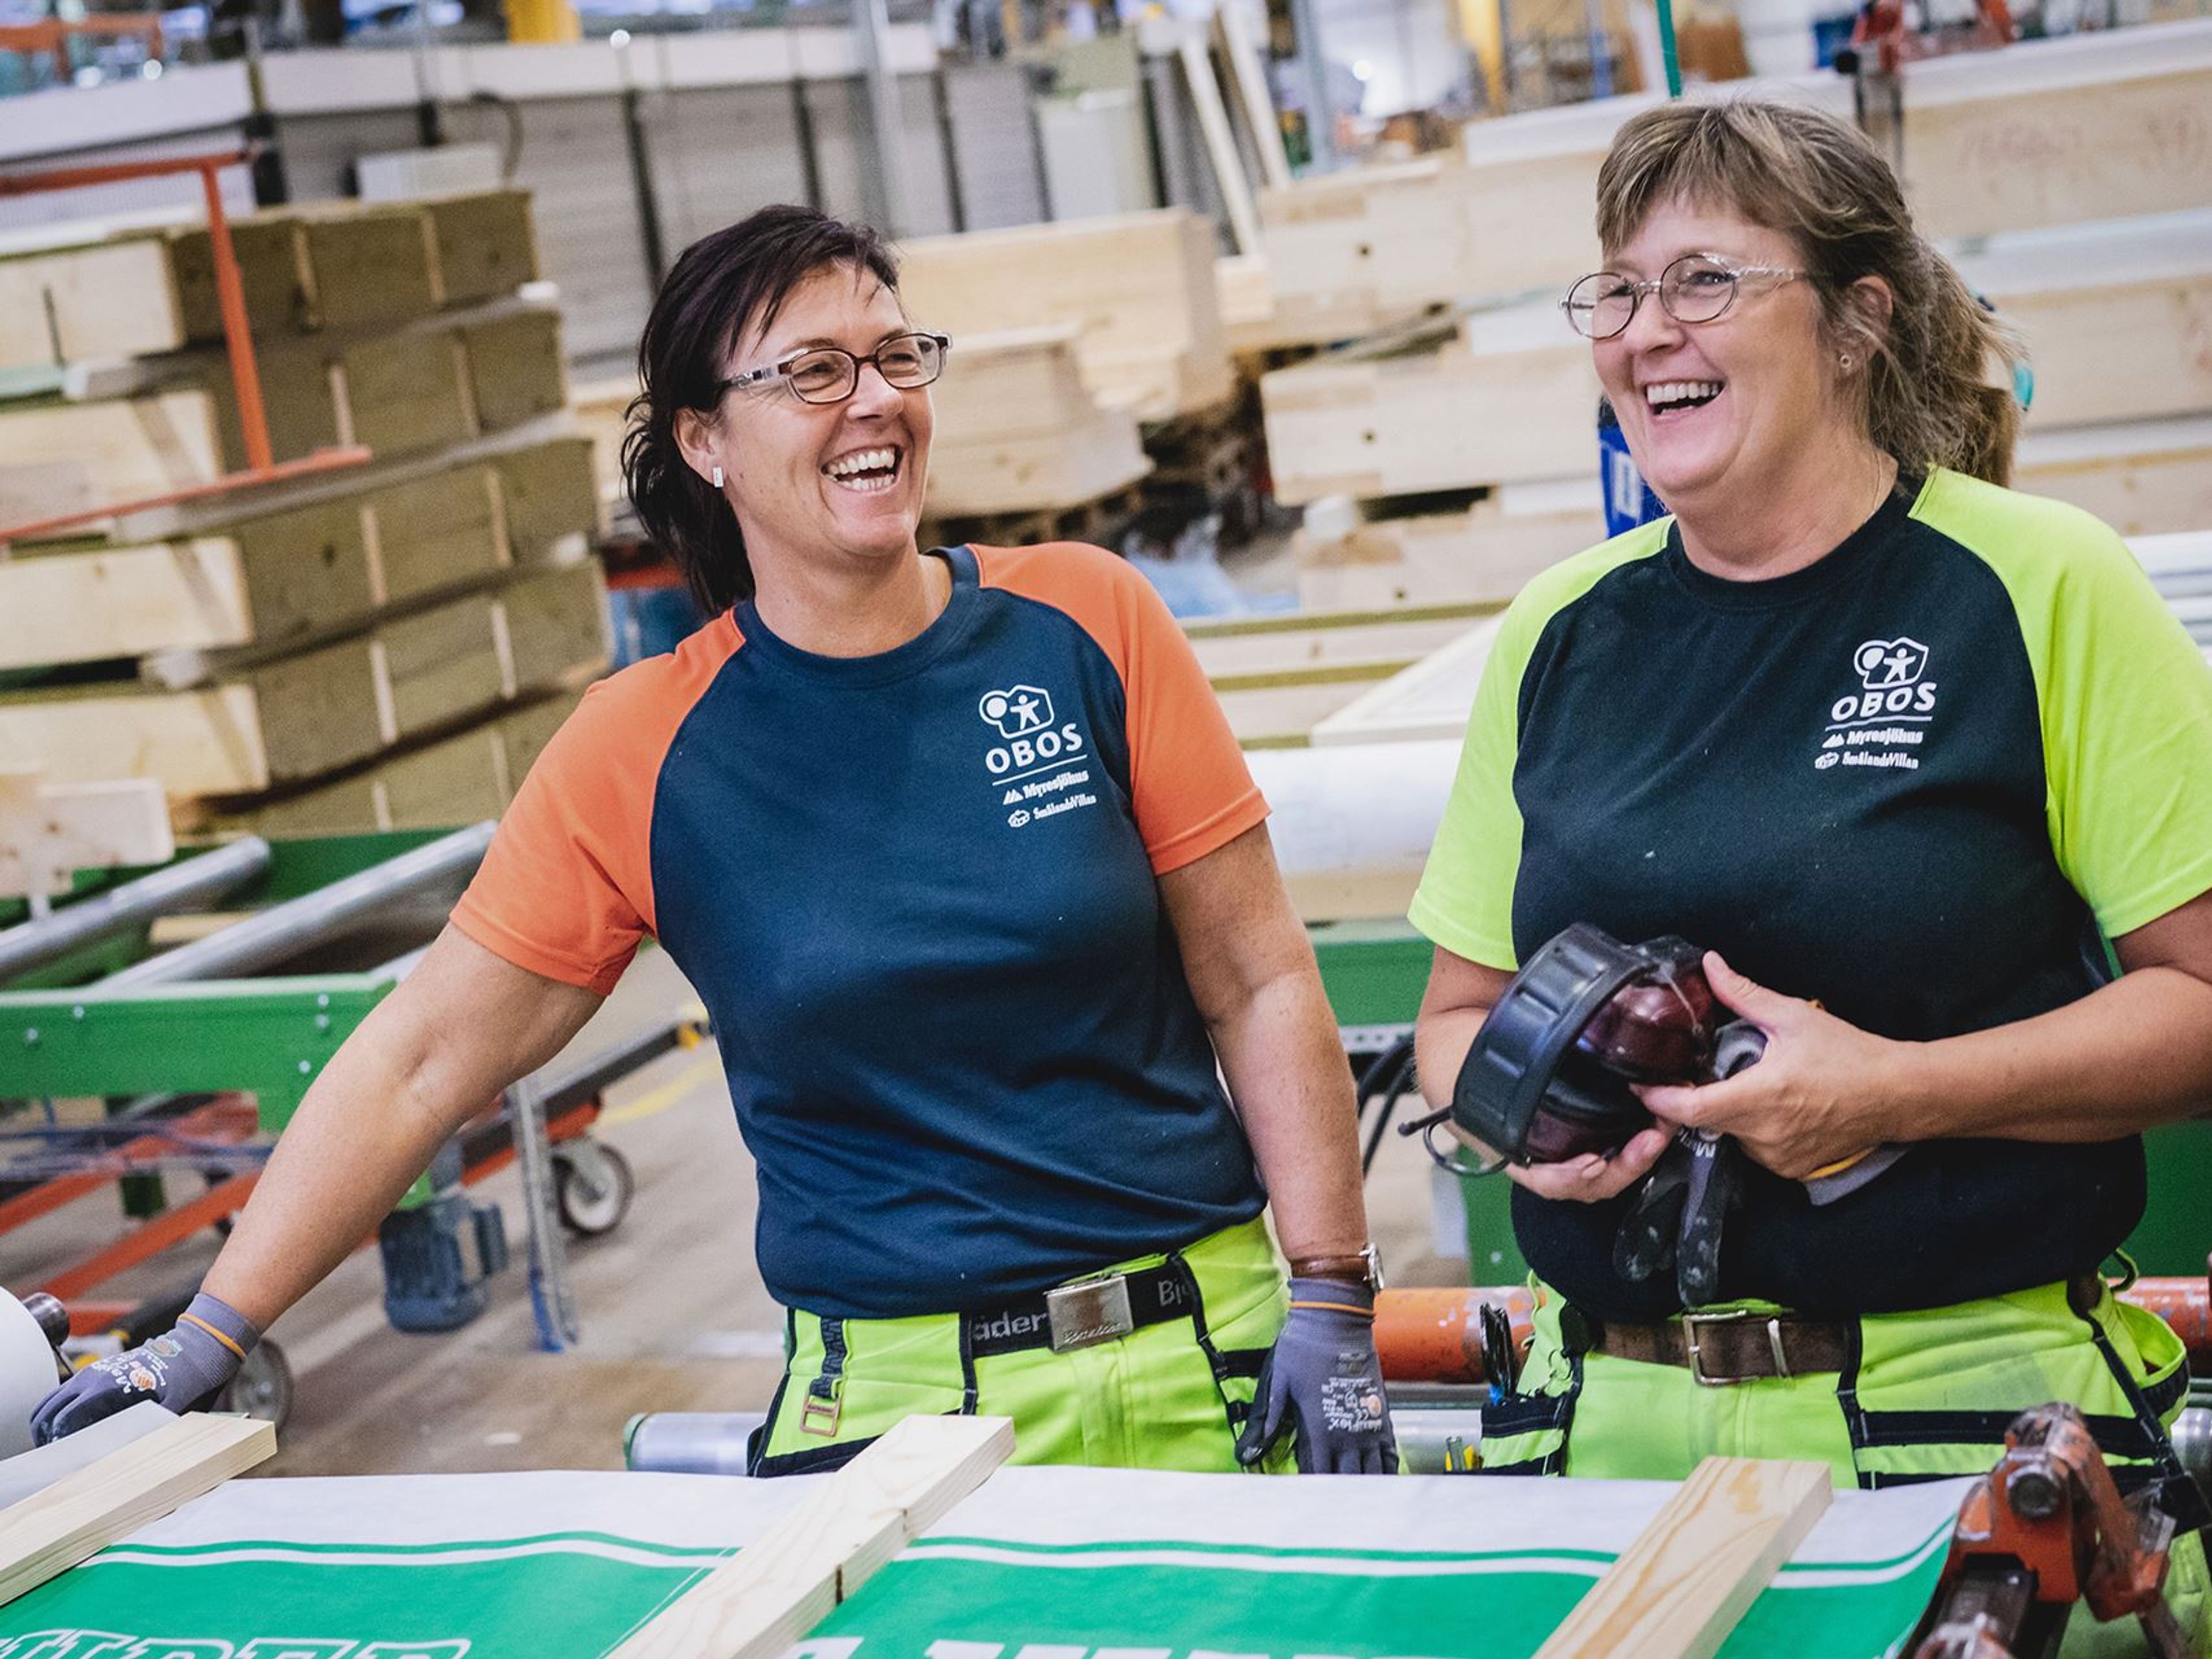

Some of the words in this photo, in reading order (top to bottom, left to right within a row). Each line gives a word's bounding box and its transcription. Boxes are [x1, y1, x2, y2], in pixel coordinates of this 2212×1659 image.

[1831, 682, 1937, 721] OBOS
[985, 723, 1083, 774] OBOS
[1846, 727, 1924, 746] Myresjöhus
